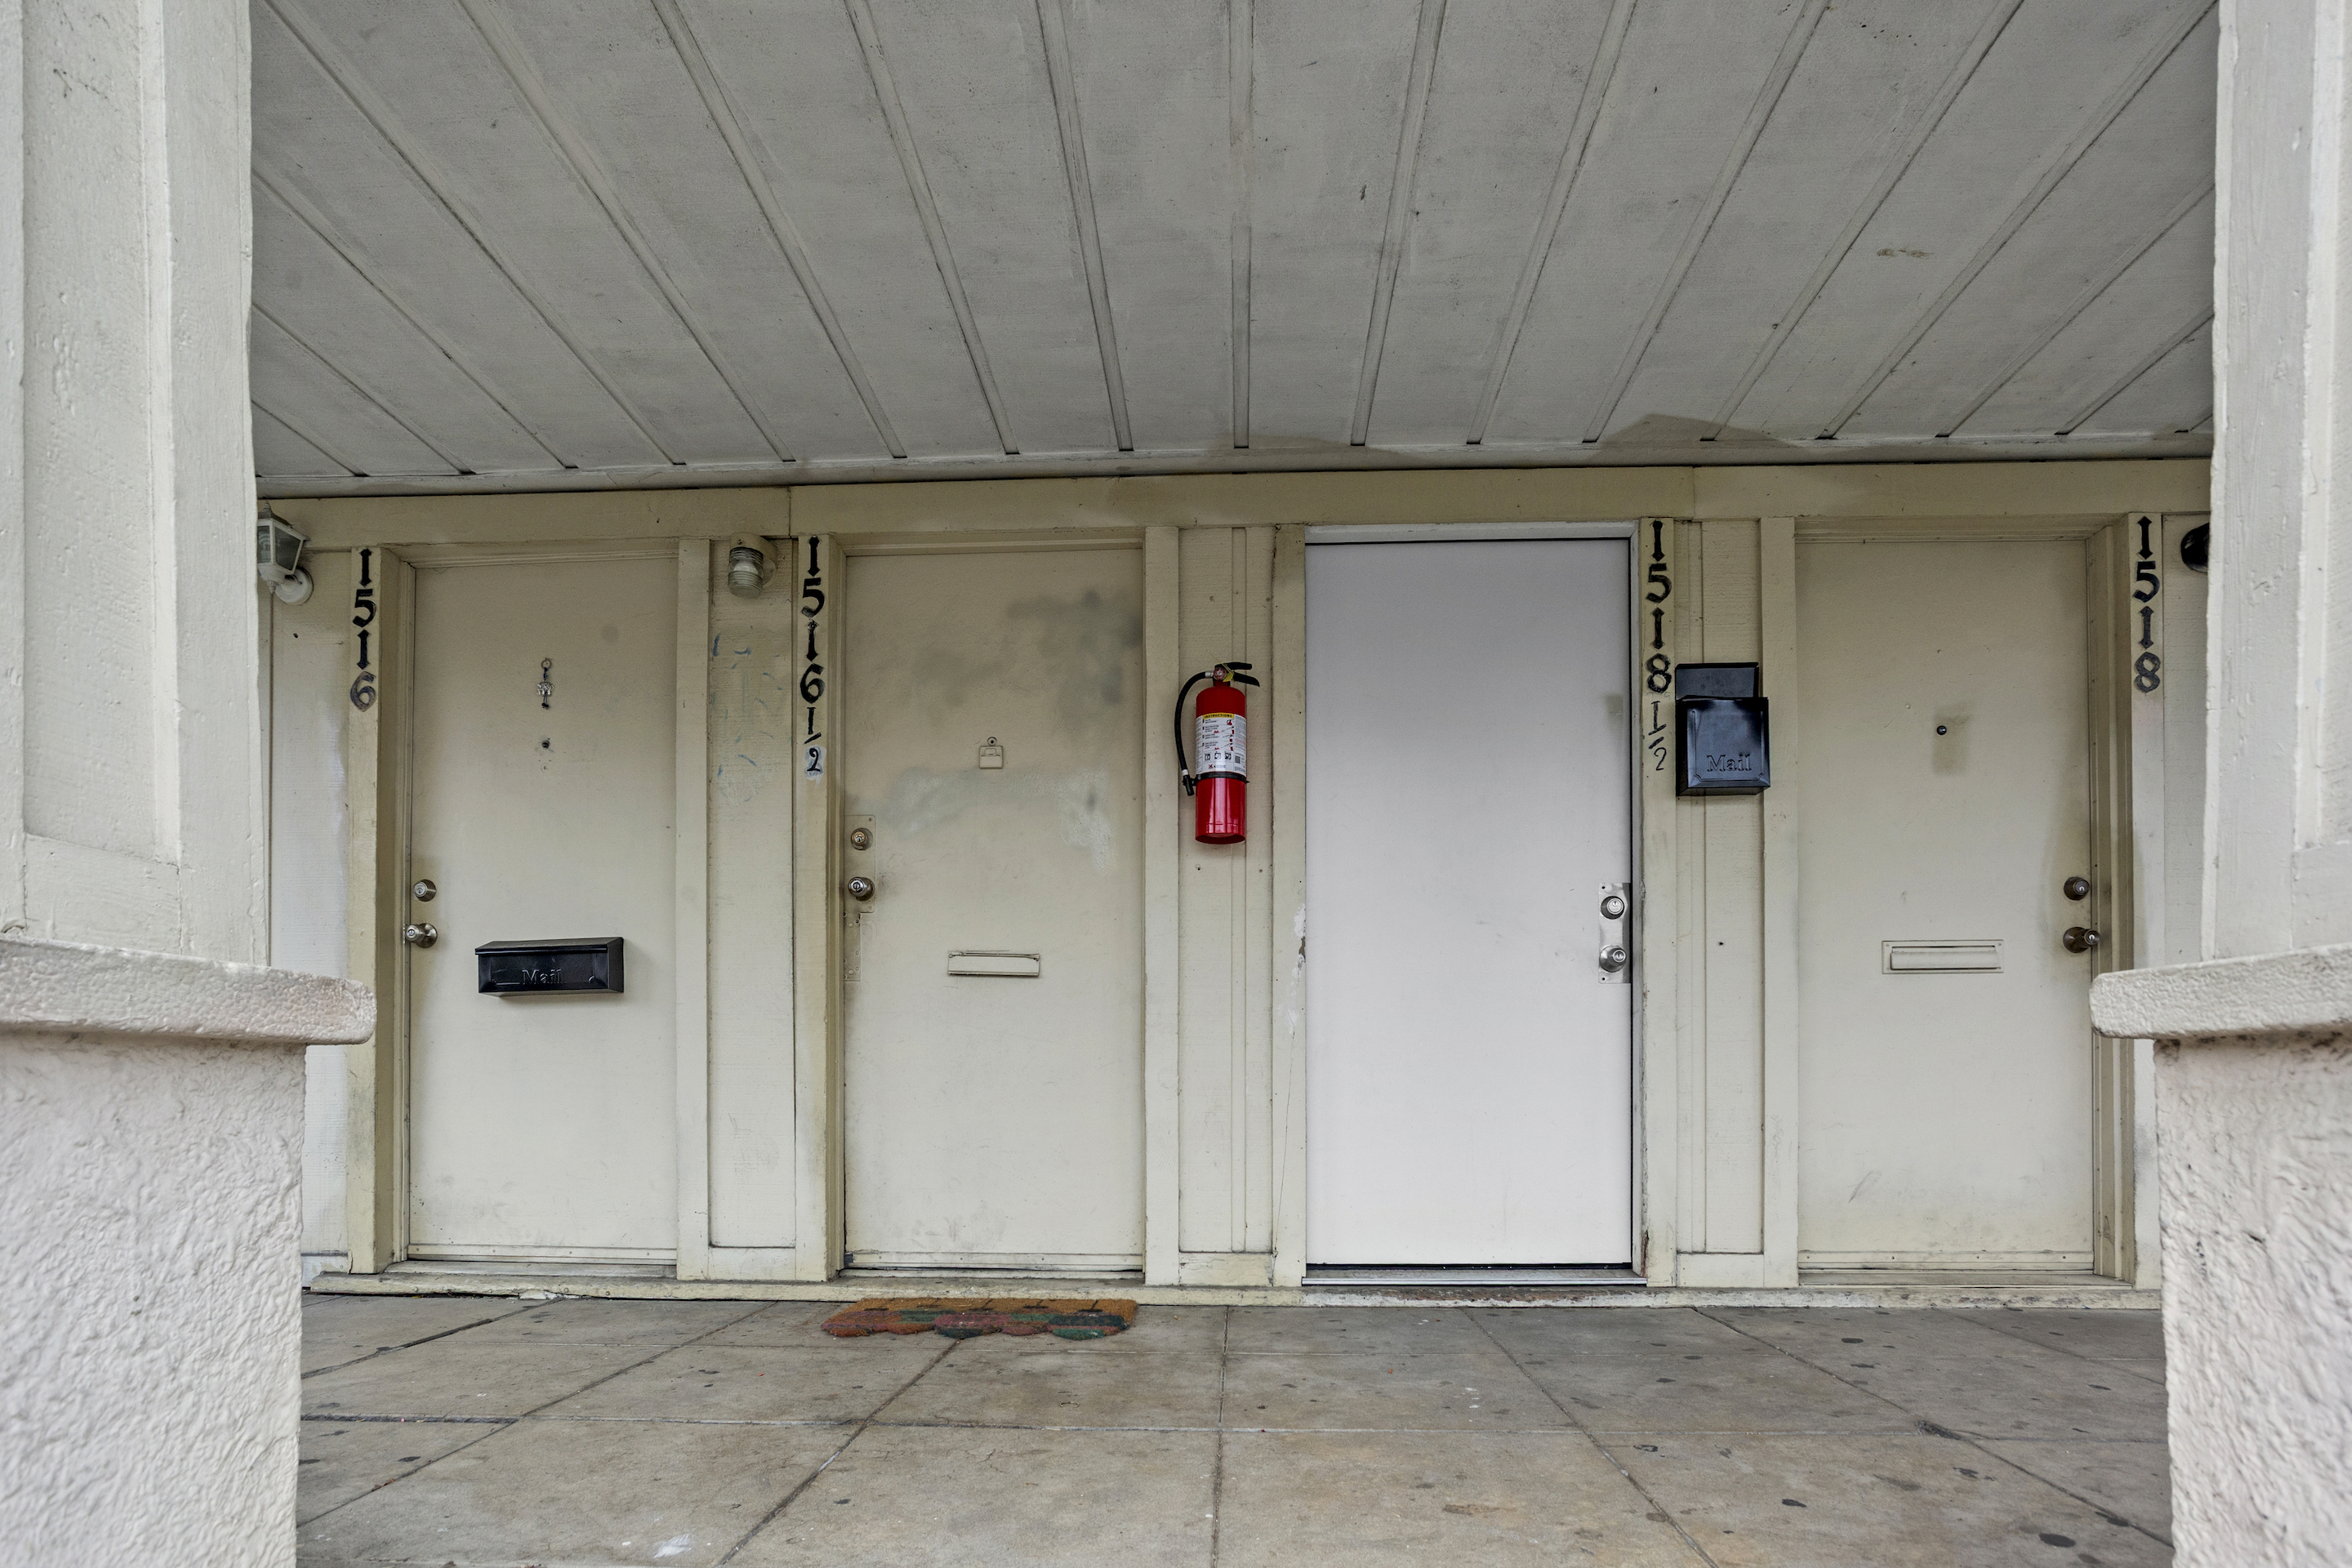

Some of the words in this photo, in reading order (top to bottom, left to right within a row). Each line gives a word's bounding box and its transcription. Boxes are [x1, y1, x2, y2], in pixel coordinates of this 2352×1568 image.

[350, 547, 376, 713] 1516
[800, 535, 826, 704] 1516
[1645, 519, 1673, 694] 1518
[2132, 515, 2161, 693] 1518
[1706, 751, 1752, 773] Mail
[521, 969, 567, 986] Mail
